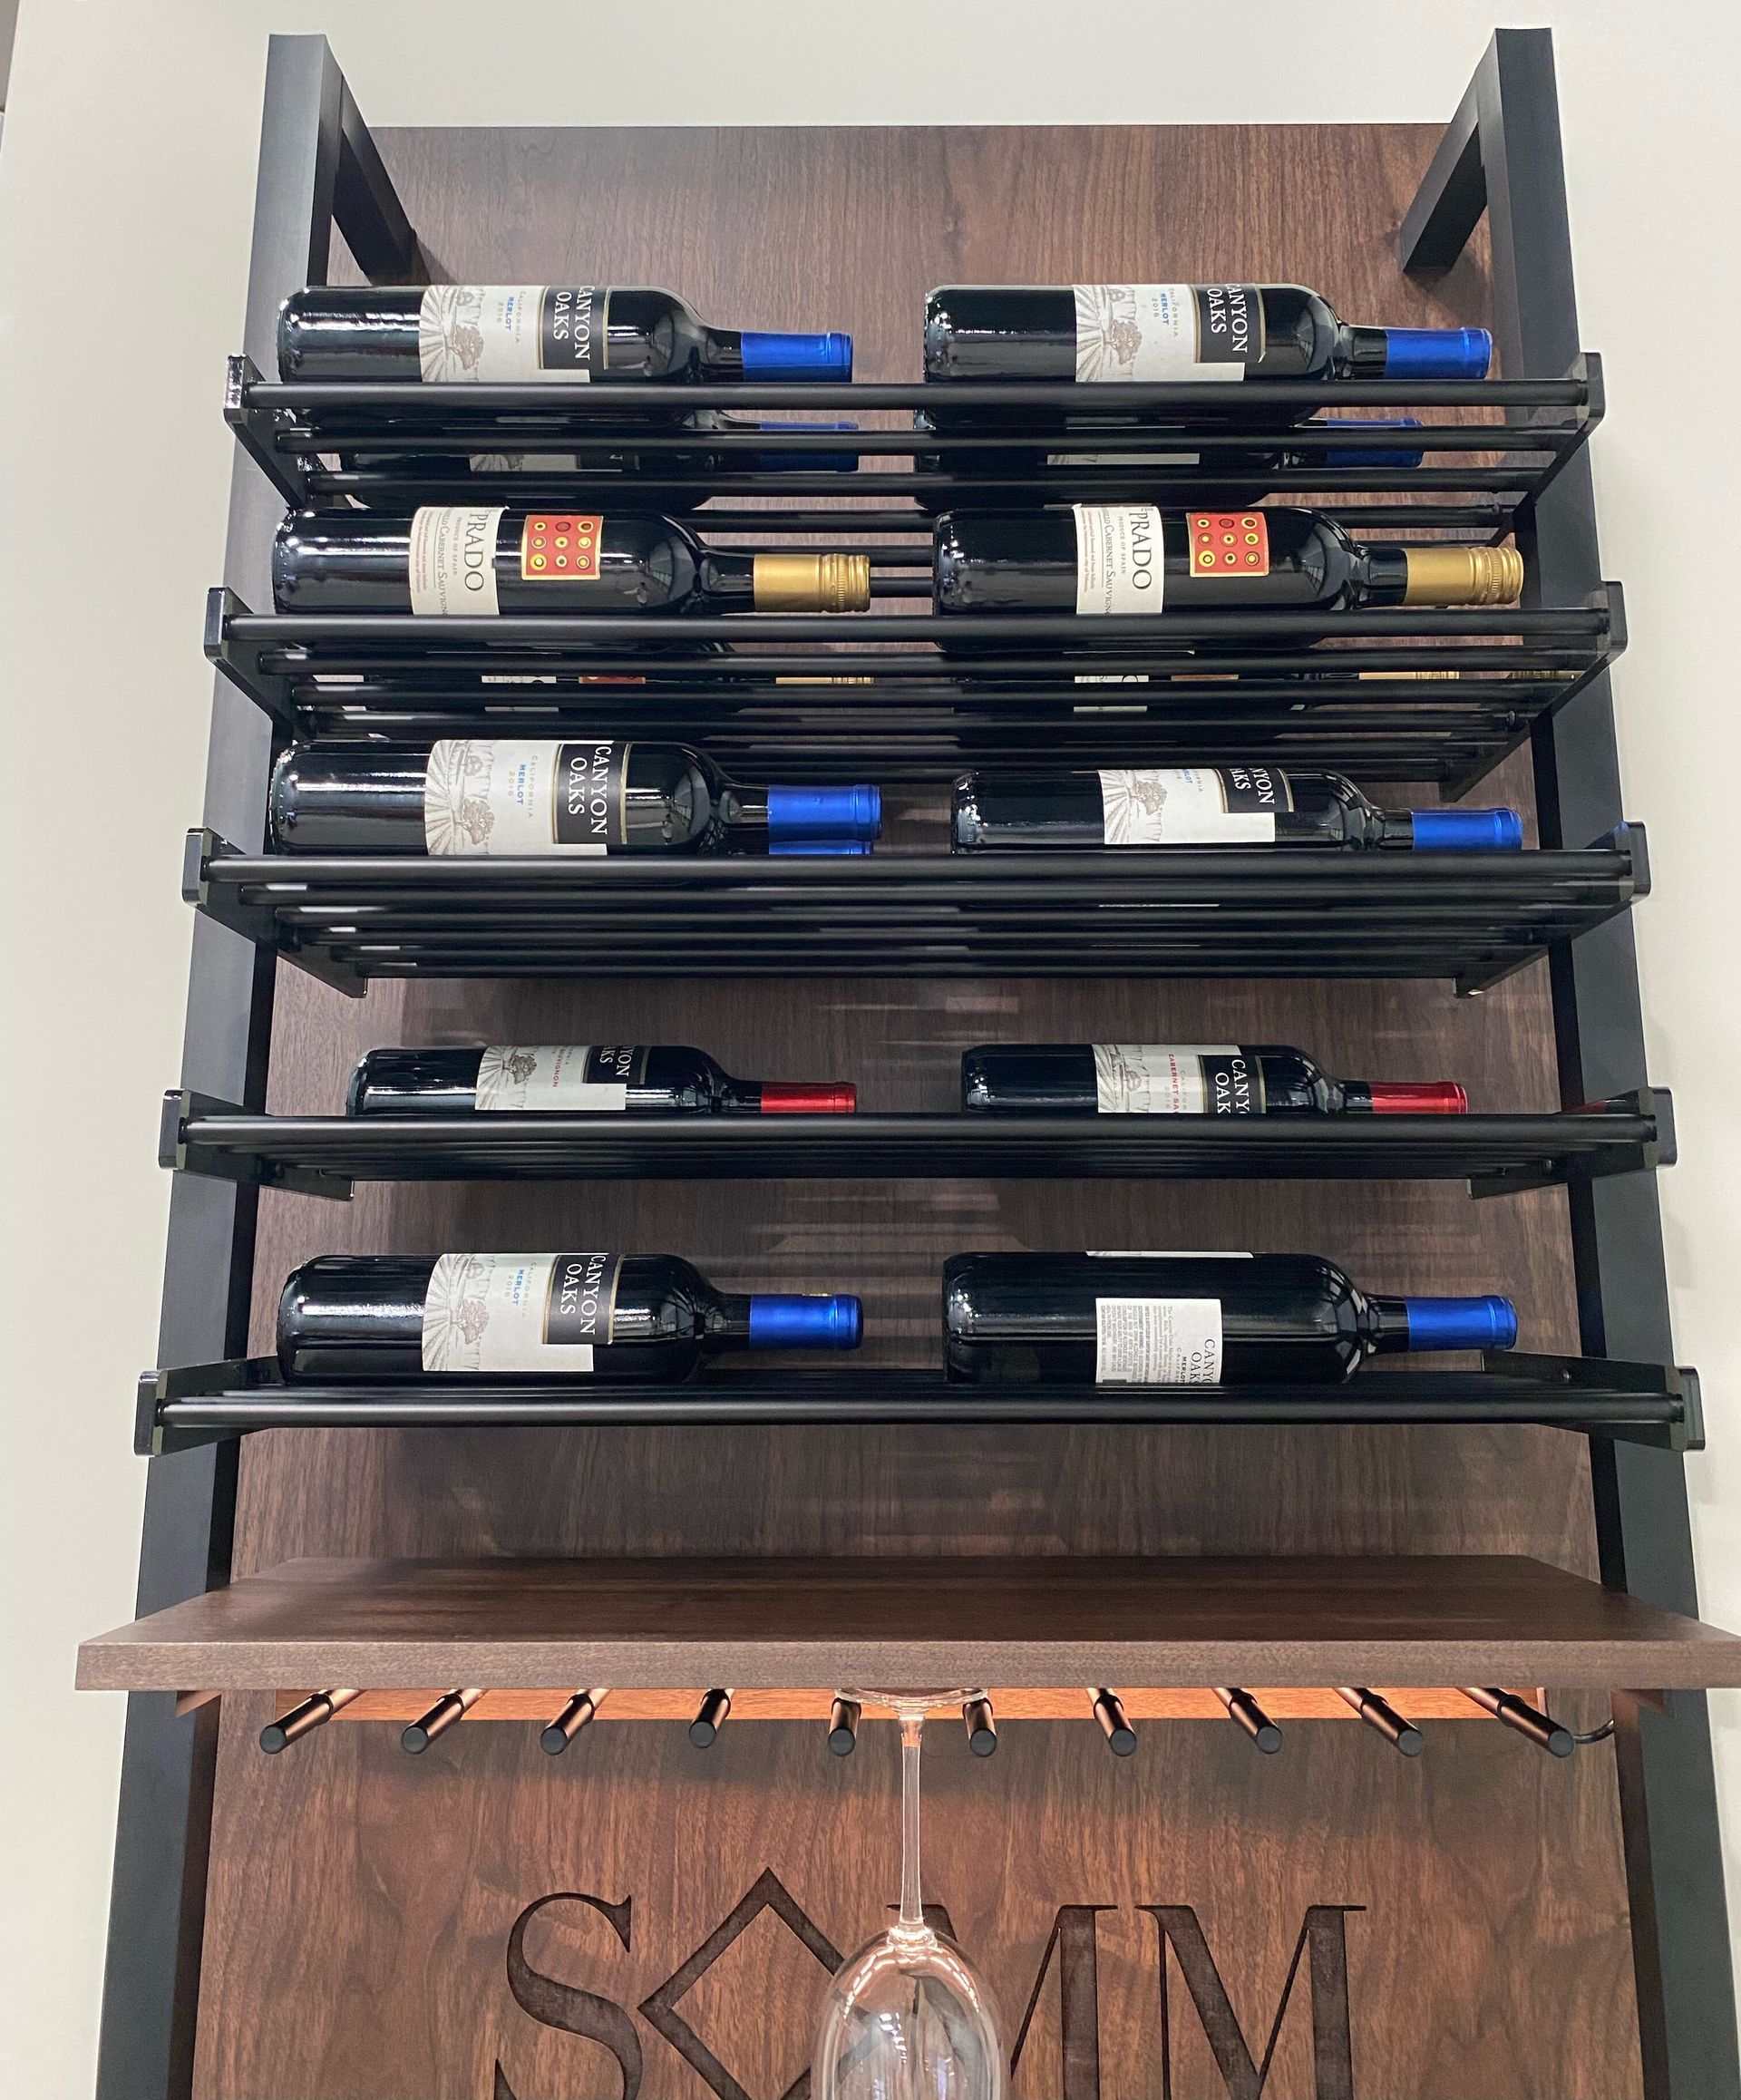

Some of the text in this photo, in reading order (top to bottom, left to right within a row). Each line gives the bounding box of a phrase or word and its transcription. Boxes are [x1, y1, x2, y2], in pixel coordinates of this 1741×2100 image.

[505, 296, 515, 331] MERLOT
[515, 291, 526, 344] CALIFORNIA
[553, 291, 572, 340] OAKS
[574, 286, 596, 360] CANYON
[1160, 293, 1169, 326] MERLOT
[1169, 288, 1179, 337] CALIFORNIA
[1207, 288, 1227, 333] OAKS
[438, 526, 450, 569] CABERNET
[453, 517, 462, 541] PRODUCE
[464, 513, 488, 591] PRADO
[1104, 525, 1114, 569] CABERNET
[1121, 542, 1125, 550] OF
[1129, 512, 1153, 590] PRADO
[517, 763, 527, 805] MERLOT
[528, 755, 538, 819] CALIFORNIA
[568, 757, 588, 815] OAKS
[589, 745, 612, 834] CANYON
[1168, 1055, 1179, 1094] CABERNET
[1231, 1059, 1250, 1113] CANY
[512, 1269, 525, 1306] MERLOT
[521, 1262, 537, 1317] CALIFORNIA
[560, 1263, 583, 1314] OAKS
[579, 1255, 606, 1335] CANYON
